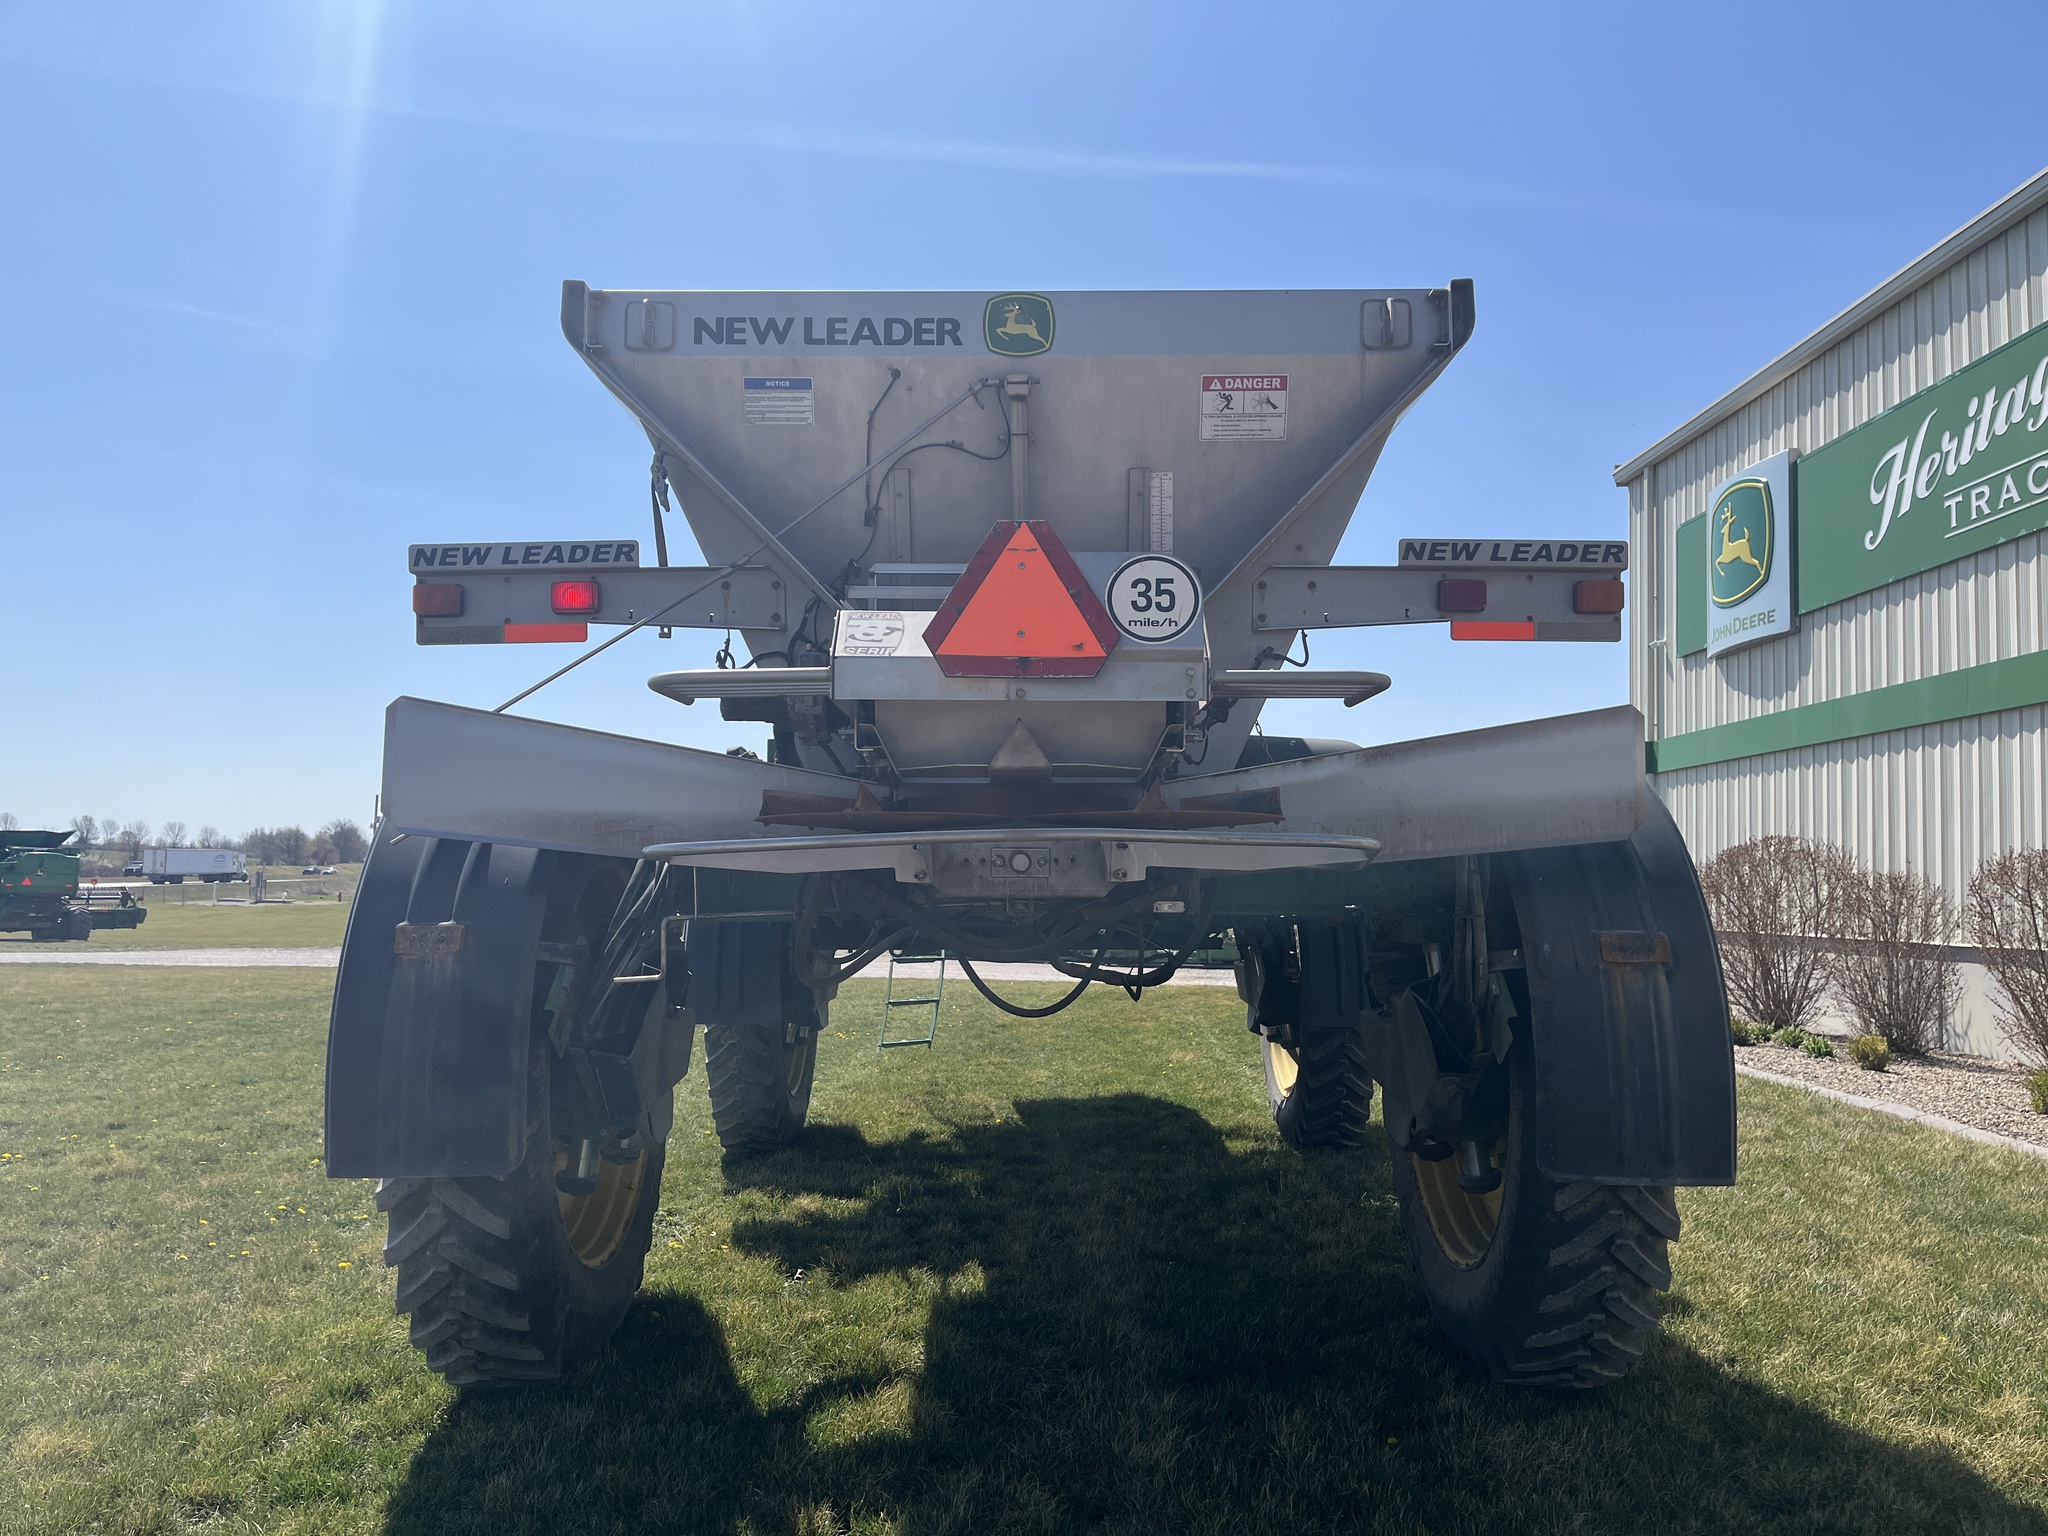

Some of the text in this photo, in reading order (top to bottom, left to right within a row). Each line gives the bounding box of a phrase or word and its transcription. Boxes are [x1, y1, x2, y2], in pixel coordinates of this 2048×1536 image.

[693, 317, 963, 346] NEW LEADER
[1224, 378, 1281, 389] DANGER
[412, 544, 637, 567] NEW LEADER
[1402, 542, 1625, 563] NEW LEADER
[1131, 578, 1176, 612] 35
[1128, 618, 1178, 627] mile/h
[1711, 609, 1776, 644] JOHN DEERE
